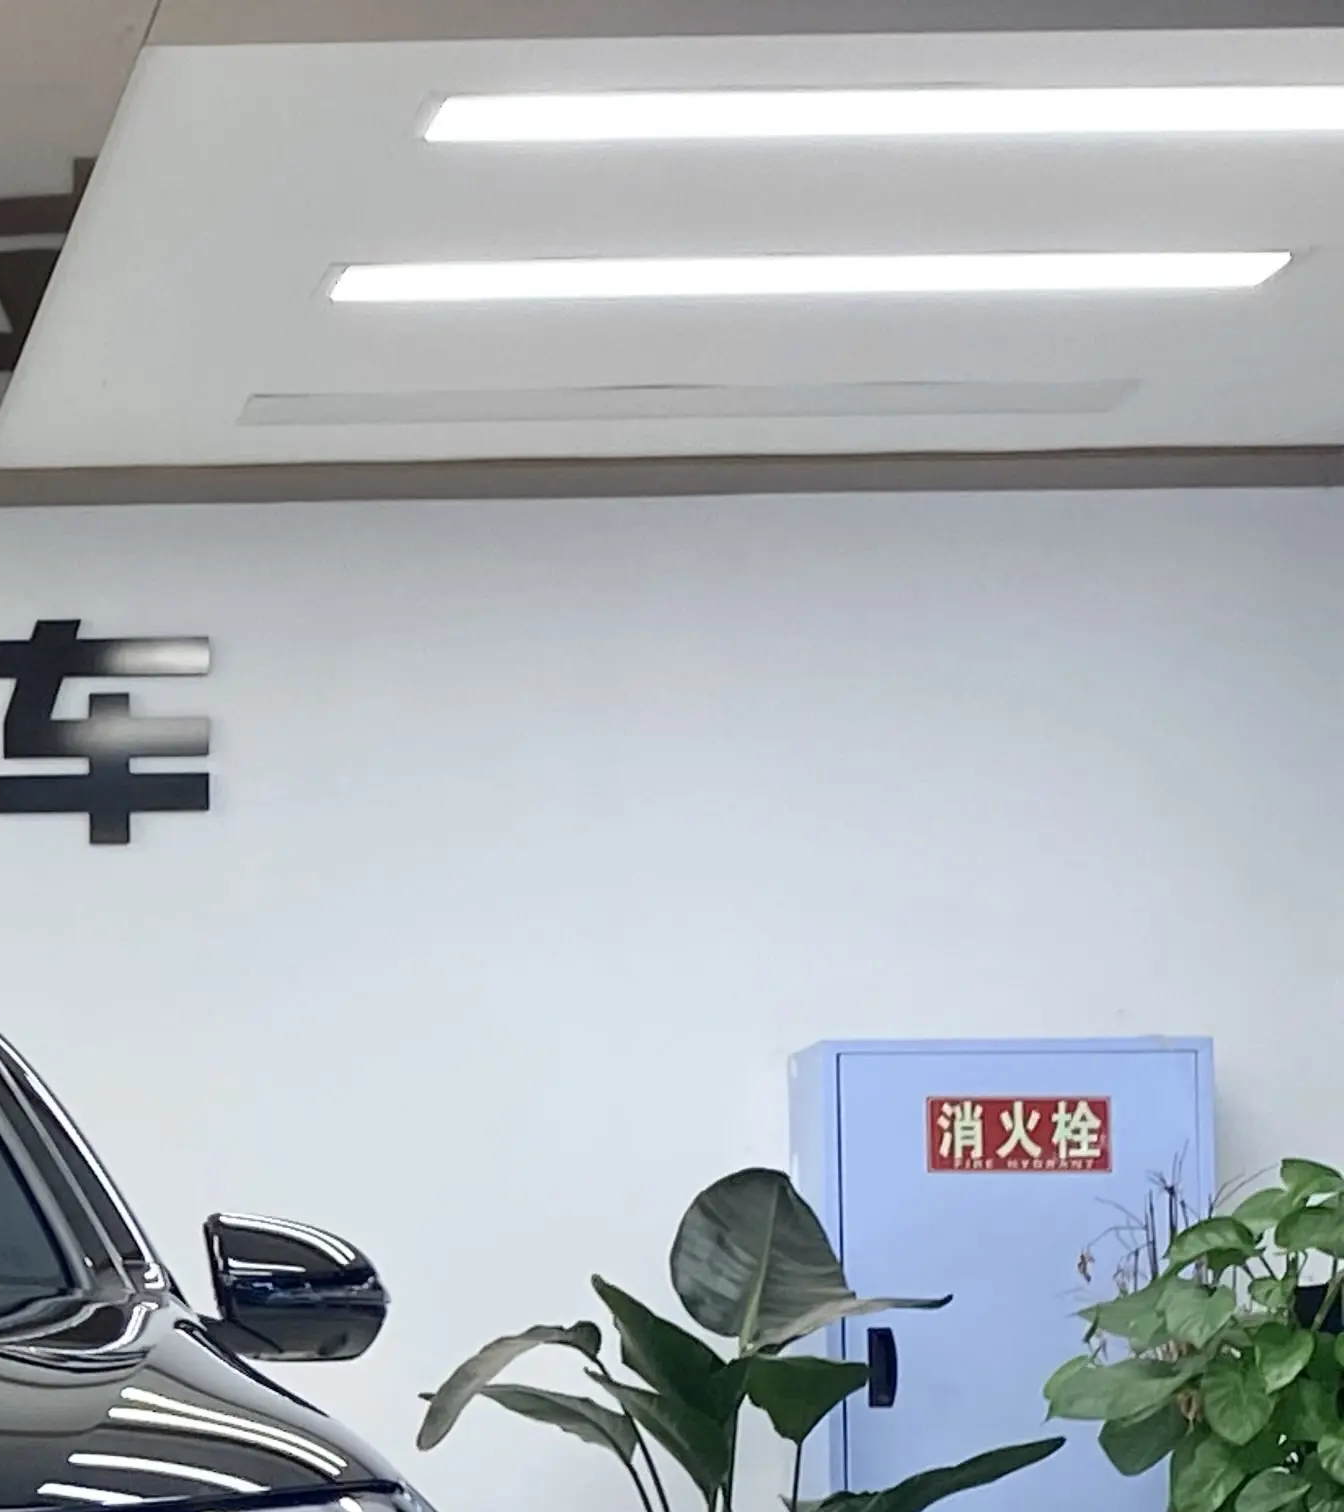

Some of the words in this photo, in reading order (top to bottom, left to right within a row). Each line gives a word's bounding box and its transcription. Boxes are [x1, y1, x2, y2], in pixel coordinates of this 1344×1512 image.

[937, 1100, 1102, 1160] 消火栓
[953, 1158, 994, 1169] FIRE
